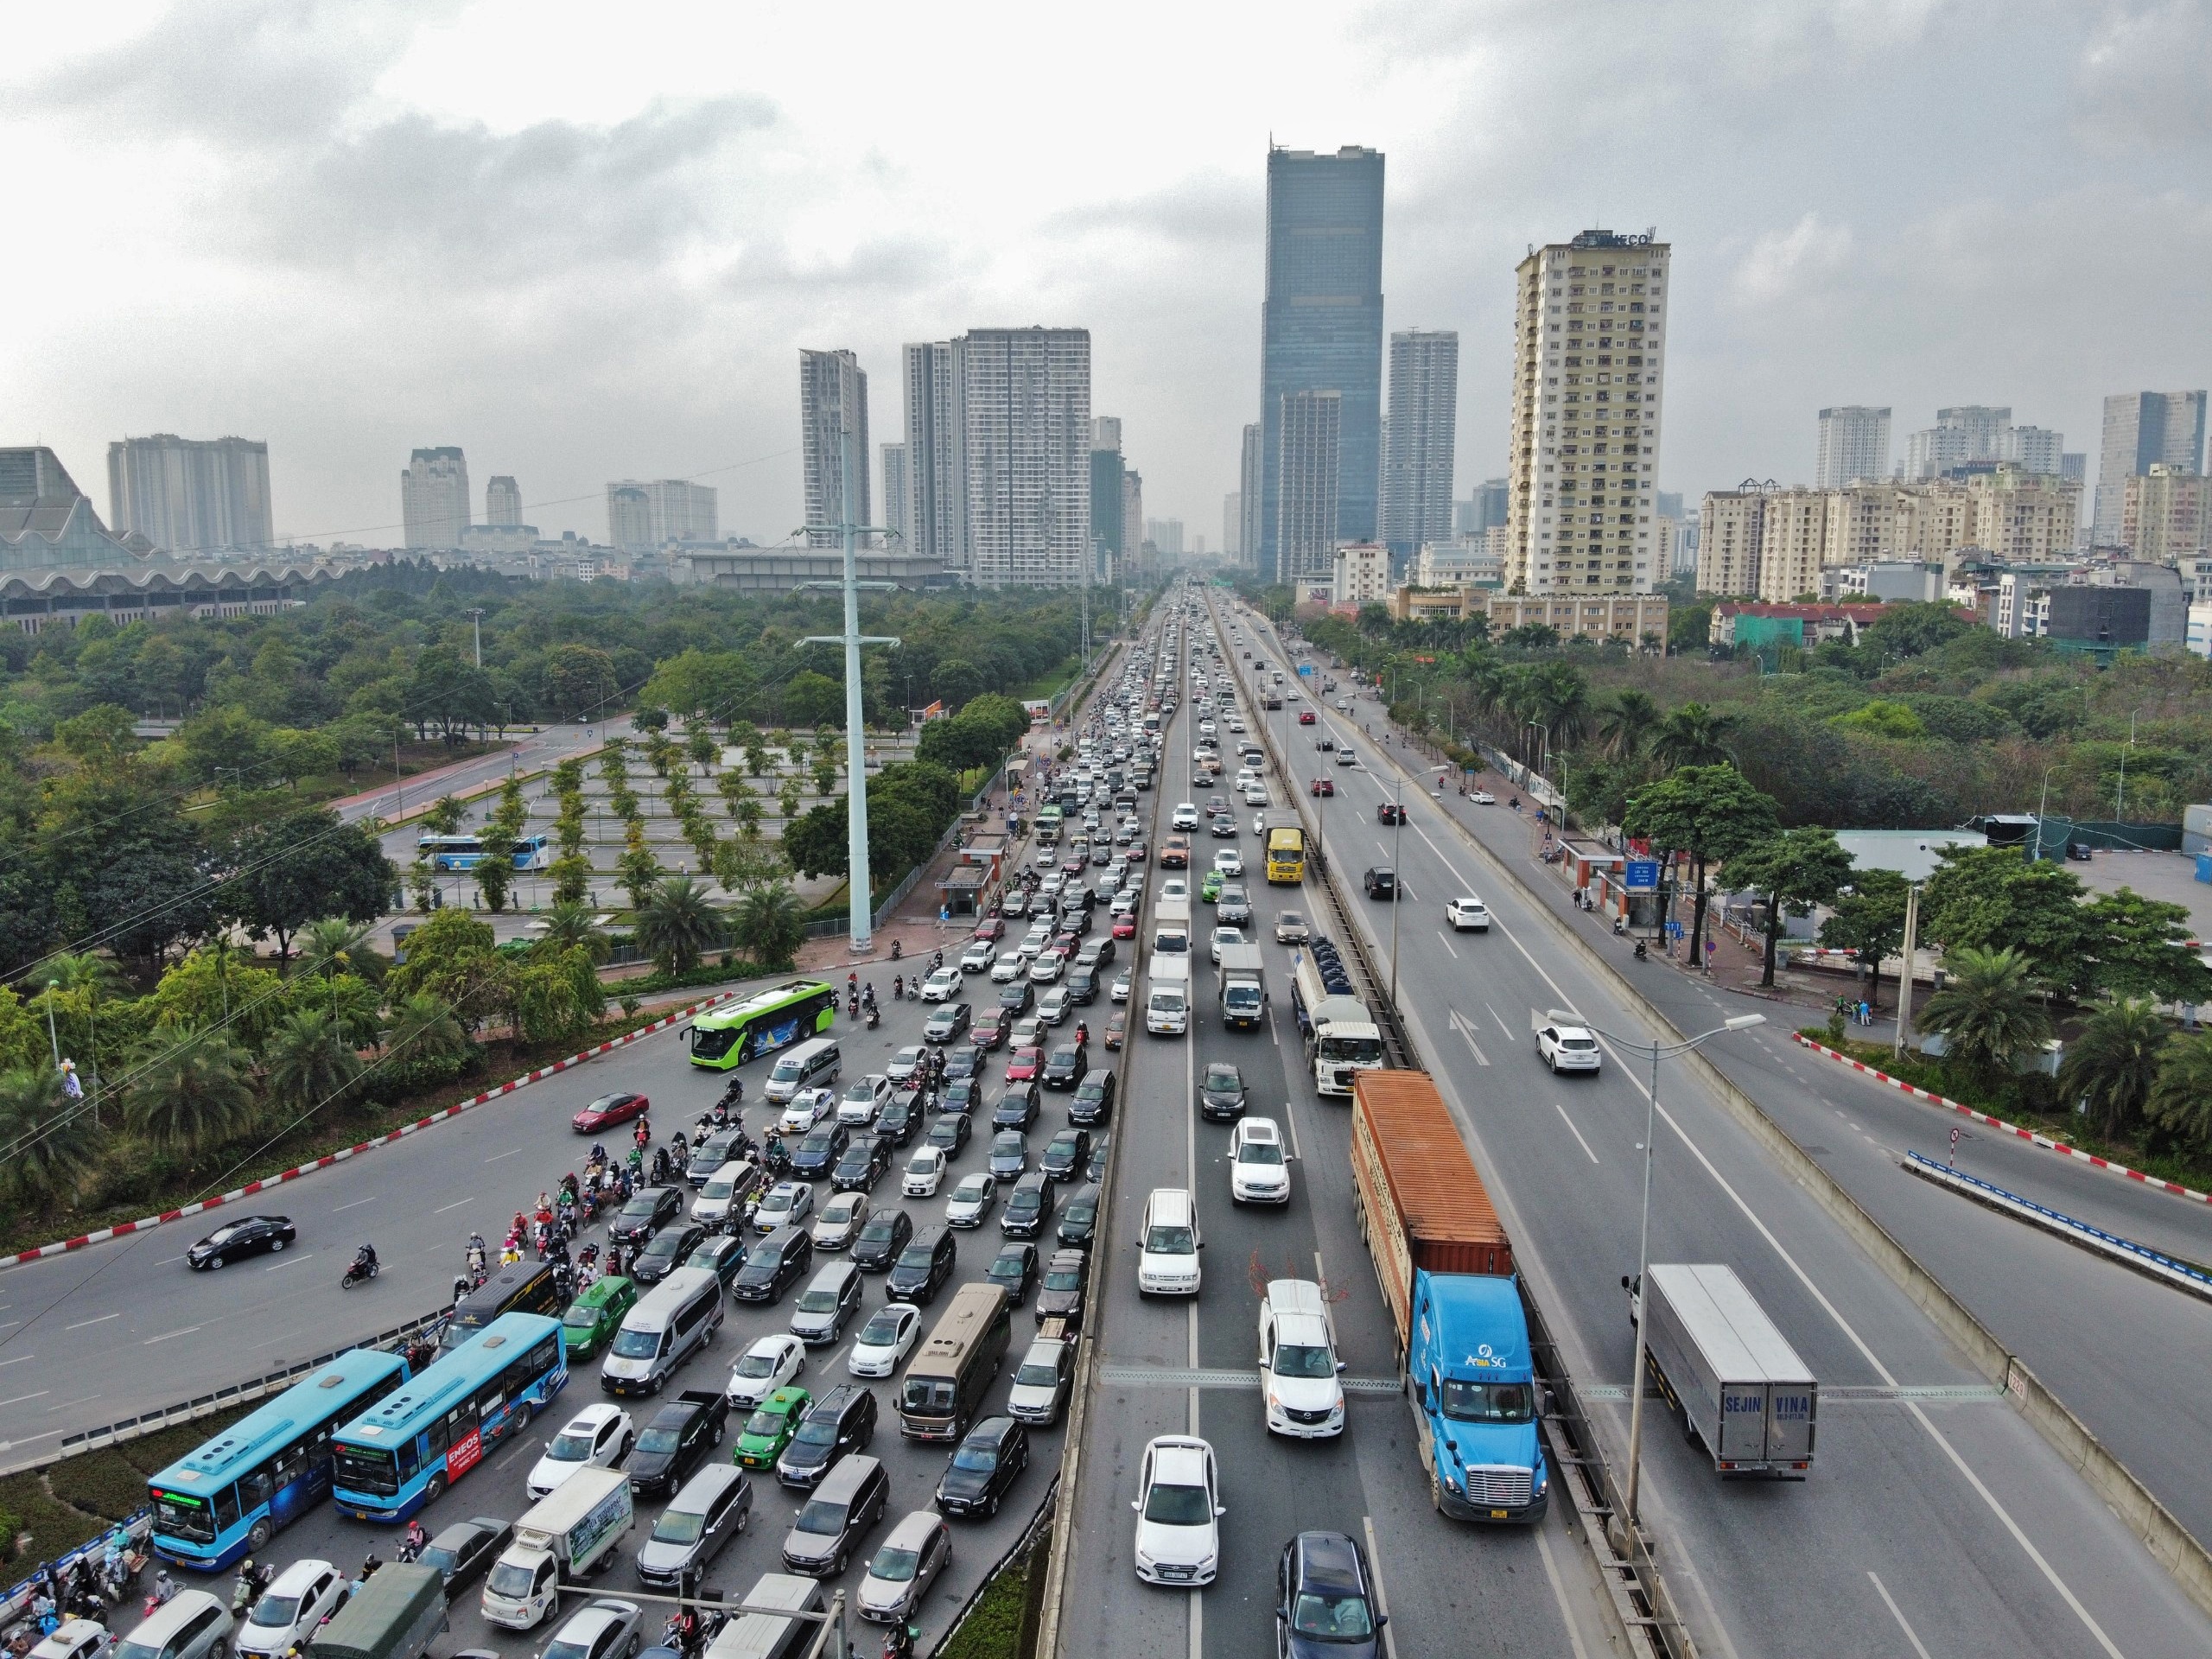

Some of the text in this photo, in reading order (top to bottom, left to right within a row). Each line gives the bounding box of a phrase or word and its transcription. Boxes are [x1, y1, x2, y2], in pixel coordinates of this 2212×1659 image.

[1491, 1357, 1506, 1368] SG
[1726, 1396, 1808, 1412] SEJIN VINA
[448, 1433, 479, 1464] ENEOS
